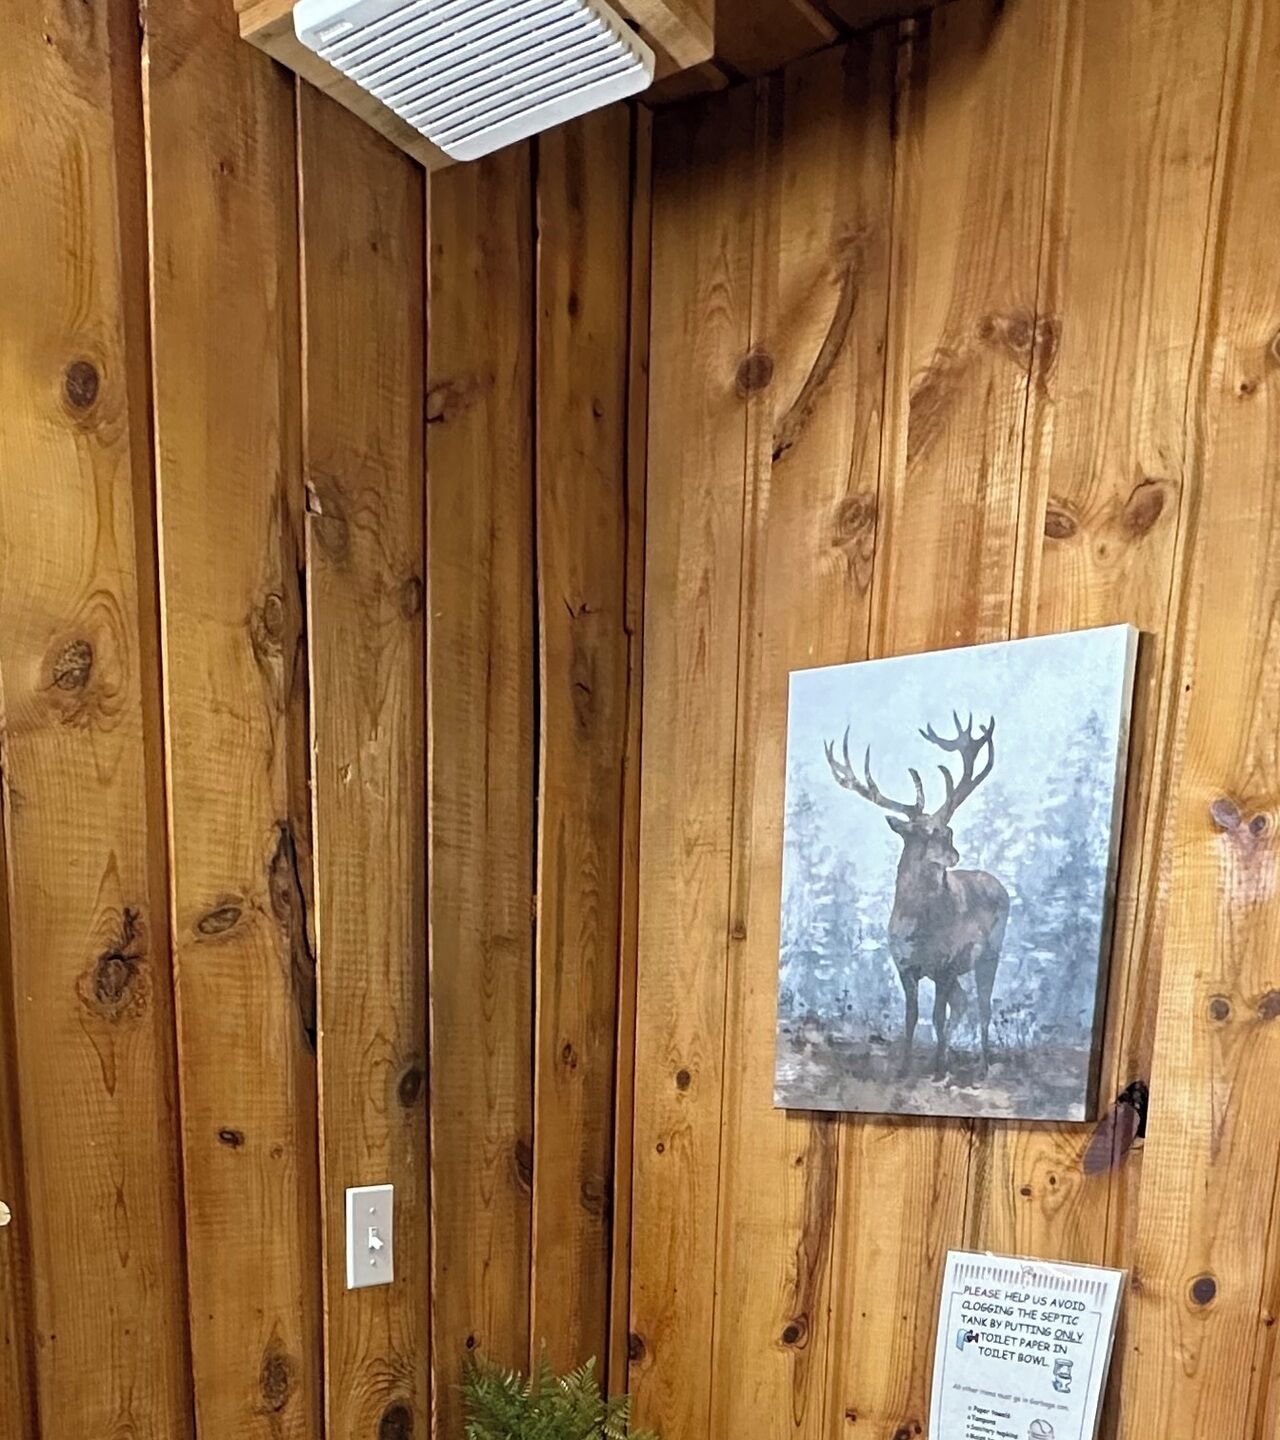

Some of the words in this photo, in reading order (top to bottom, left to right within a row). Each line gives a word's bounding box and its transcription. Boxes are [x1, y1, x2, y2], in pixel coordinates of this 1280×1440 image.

[963, 1285, 1001, 1300] PLEASE
[1004, 1291, 1030, 1303] HELP
[1033, 1295, 1047, 1306] US
[1050, 1298, 1086, 1312] AVOID
[961, 1300, 1014, 1316] CLOGGING
[1018, 1307, 1038, 1320] THE
[1040, 1311, 1080, 1326] SEPTIC
[961, 1314, 988, 1327] TANK
[989, 1318, 1003, 1329] BY
[1004, 1321, 1052, 1337] PUTTING
[1053, 1328, 1084, 1343] ONLY
[980, 1331, 1018, 1346] TOILET
[1019, 1338, 1051, 1352] PAPER
[1052, 1343, 1068, 1355] IN
[978, 1346, 1017, 1360] TOILET
[973, 1405, 990, 1414] Paper
[970, 1424, 995, 1435] Sanitary
[971, 1414, 996, 1426] Tampons
